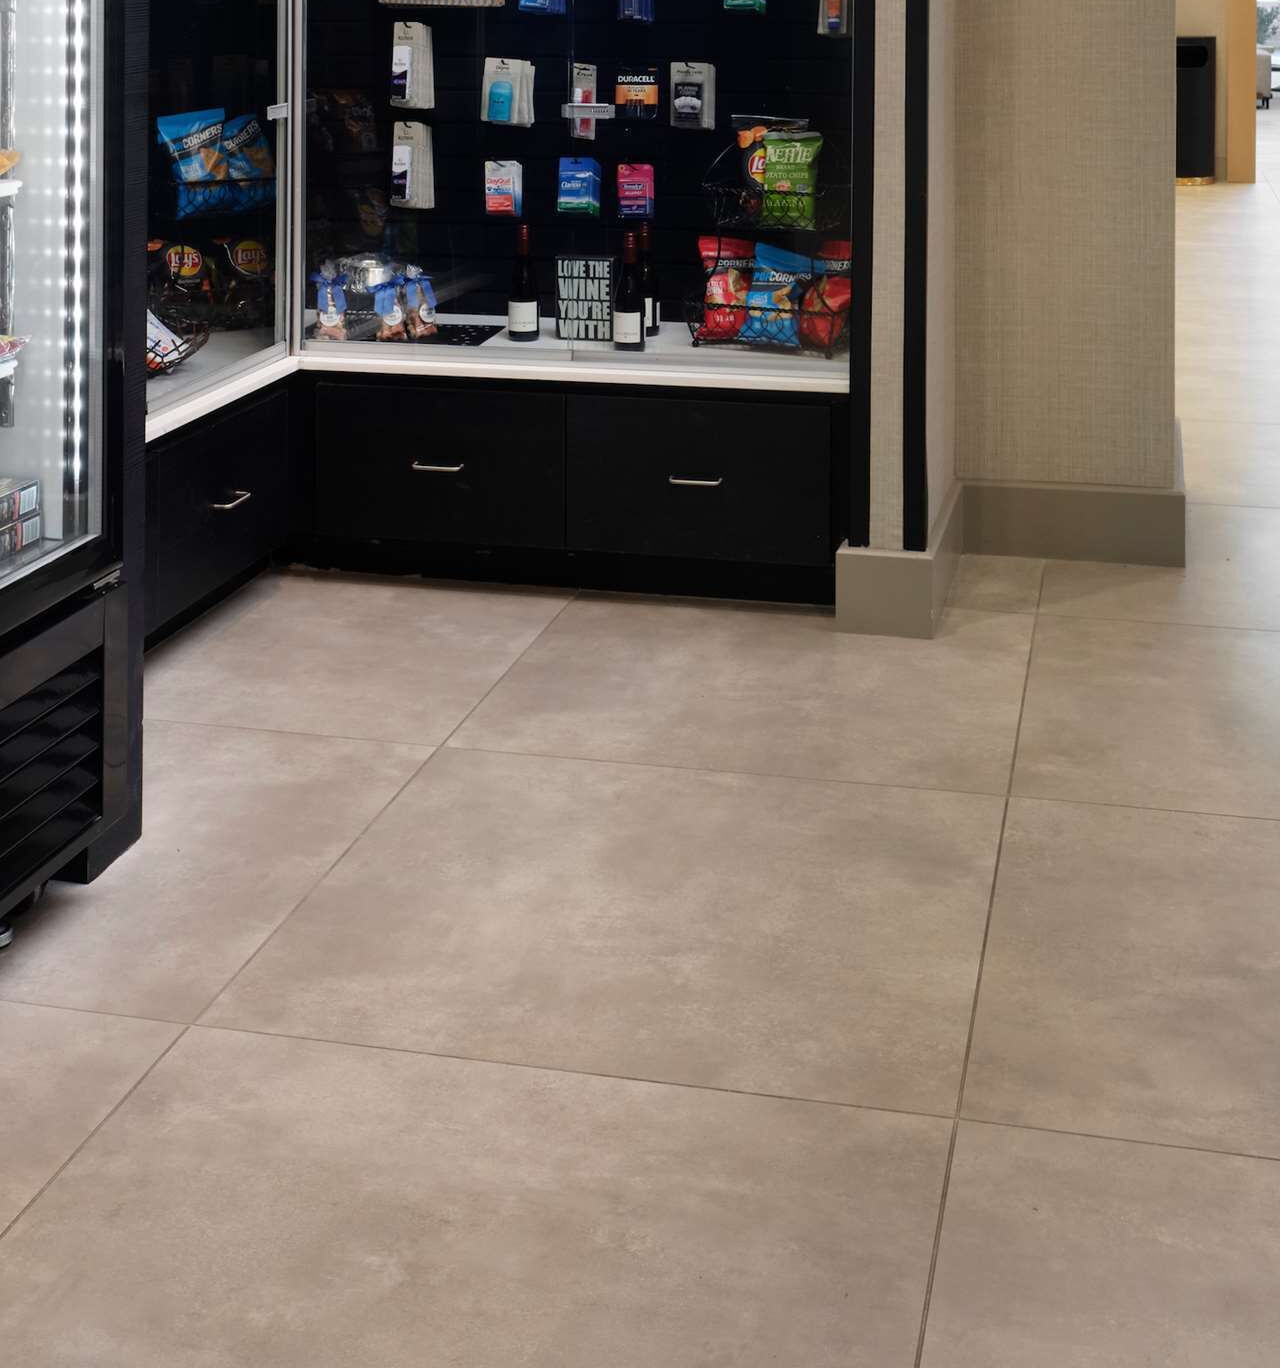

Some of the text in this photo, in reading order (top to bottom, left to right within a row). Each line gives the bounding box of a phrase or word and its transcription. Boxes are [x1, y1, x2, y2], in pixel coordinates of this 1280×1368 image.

[617, 75, 655, 83] DURACELL
[558, 259, 610, 278] LOVE THE
[558, 278, 610, 301] WINE
[558, 300, 610, 320] YOU'RE
[558, 319, 610, 340] WITH
